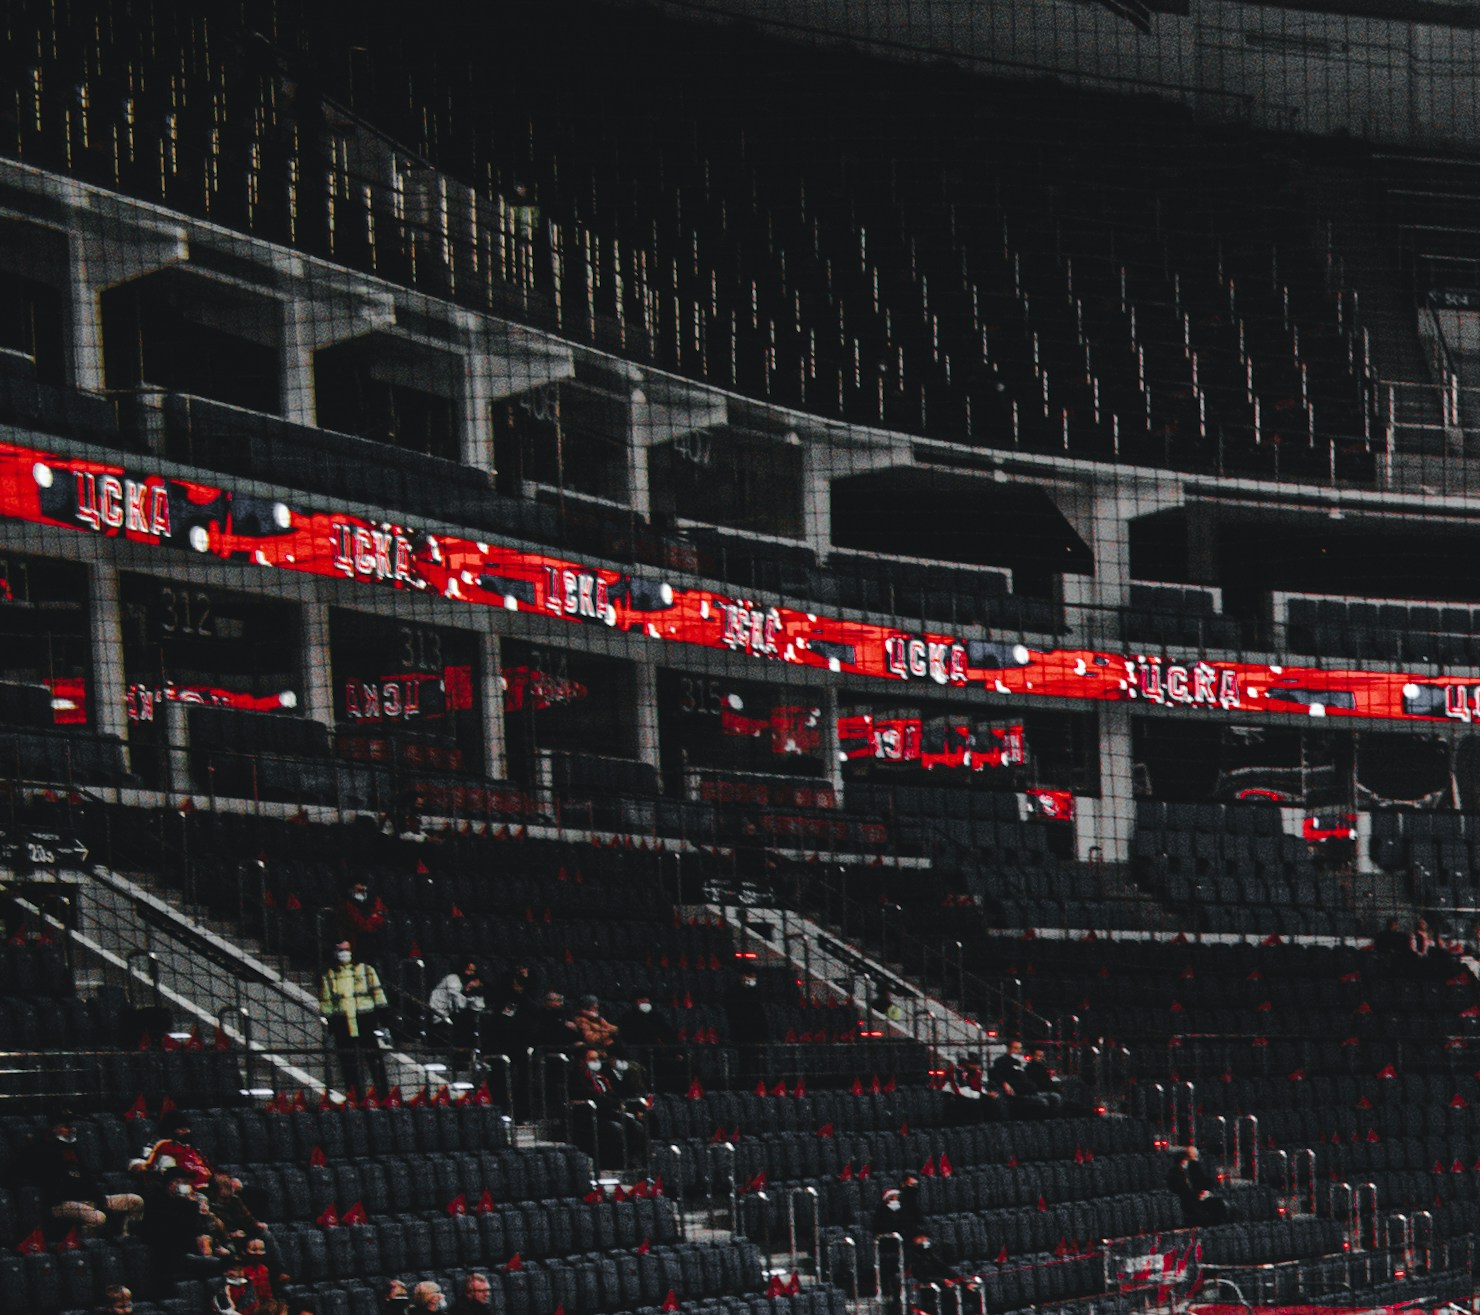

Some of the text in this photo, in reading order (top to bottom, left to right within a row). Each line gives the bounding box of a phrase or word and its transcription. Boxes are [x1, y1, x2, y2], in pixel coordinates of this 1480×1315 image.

[73, 470, 172, 539] ЦСКА
[331, 522, 412, 580] ЦСКА
[160, 586, 214, 635] 312
[543, 567, 610, 620] ЦСКА
[400, 627, 443, 669] 313
[885, 637, 969, 686] ЦСКА
[680, 675, 722, 715] 315
[1139, 666, 1242, 712] ЦСКА
